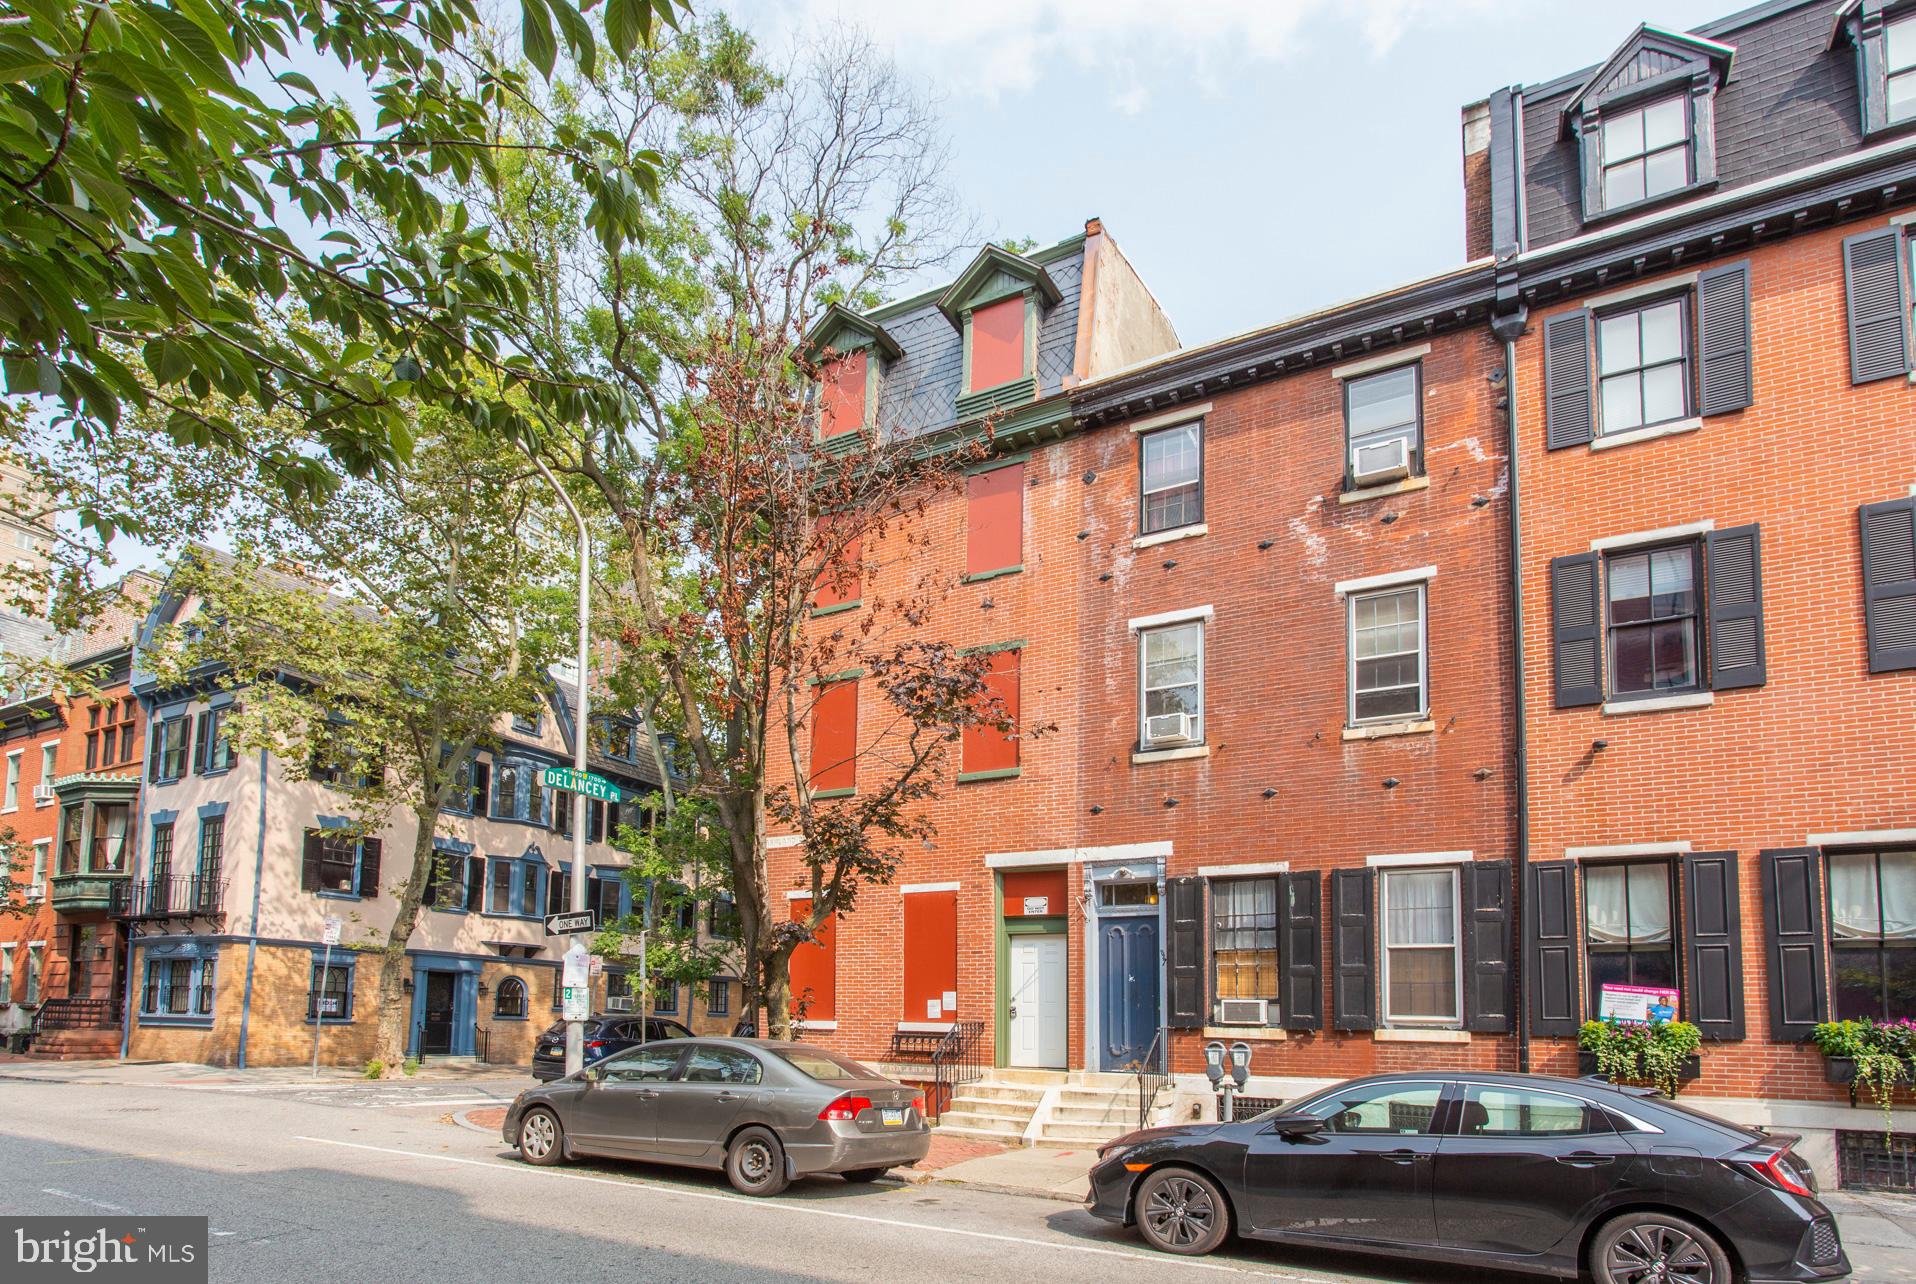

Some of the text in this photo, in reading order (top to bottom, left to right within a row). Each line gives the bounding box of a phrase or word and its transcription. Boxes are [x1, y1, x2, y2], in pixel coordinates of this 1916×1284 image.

[588, 775, 602, 783] 1700
[547, 771, 619, 802] DELANCEY PL
[559, 917, 588, 929] ONE WAY
[565, 988, 571, 998] 2
